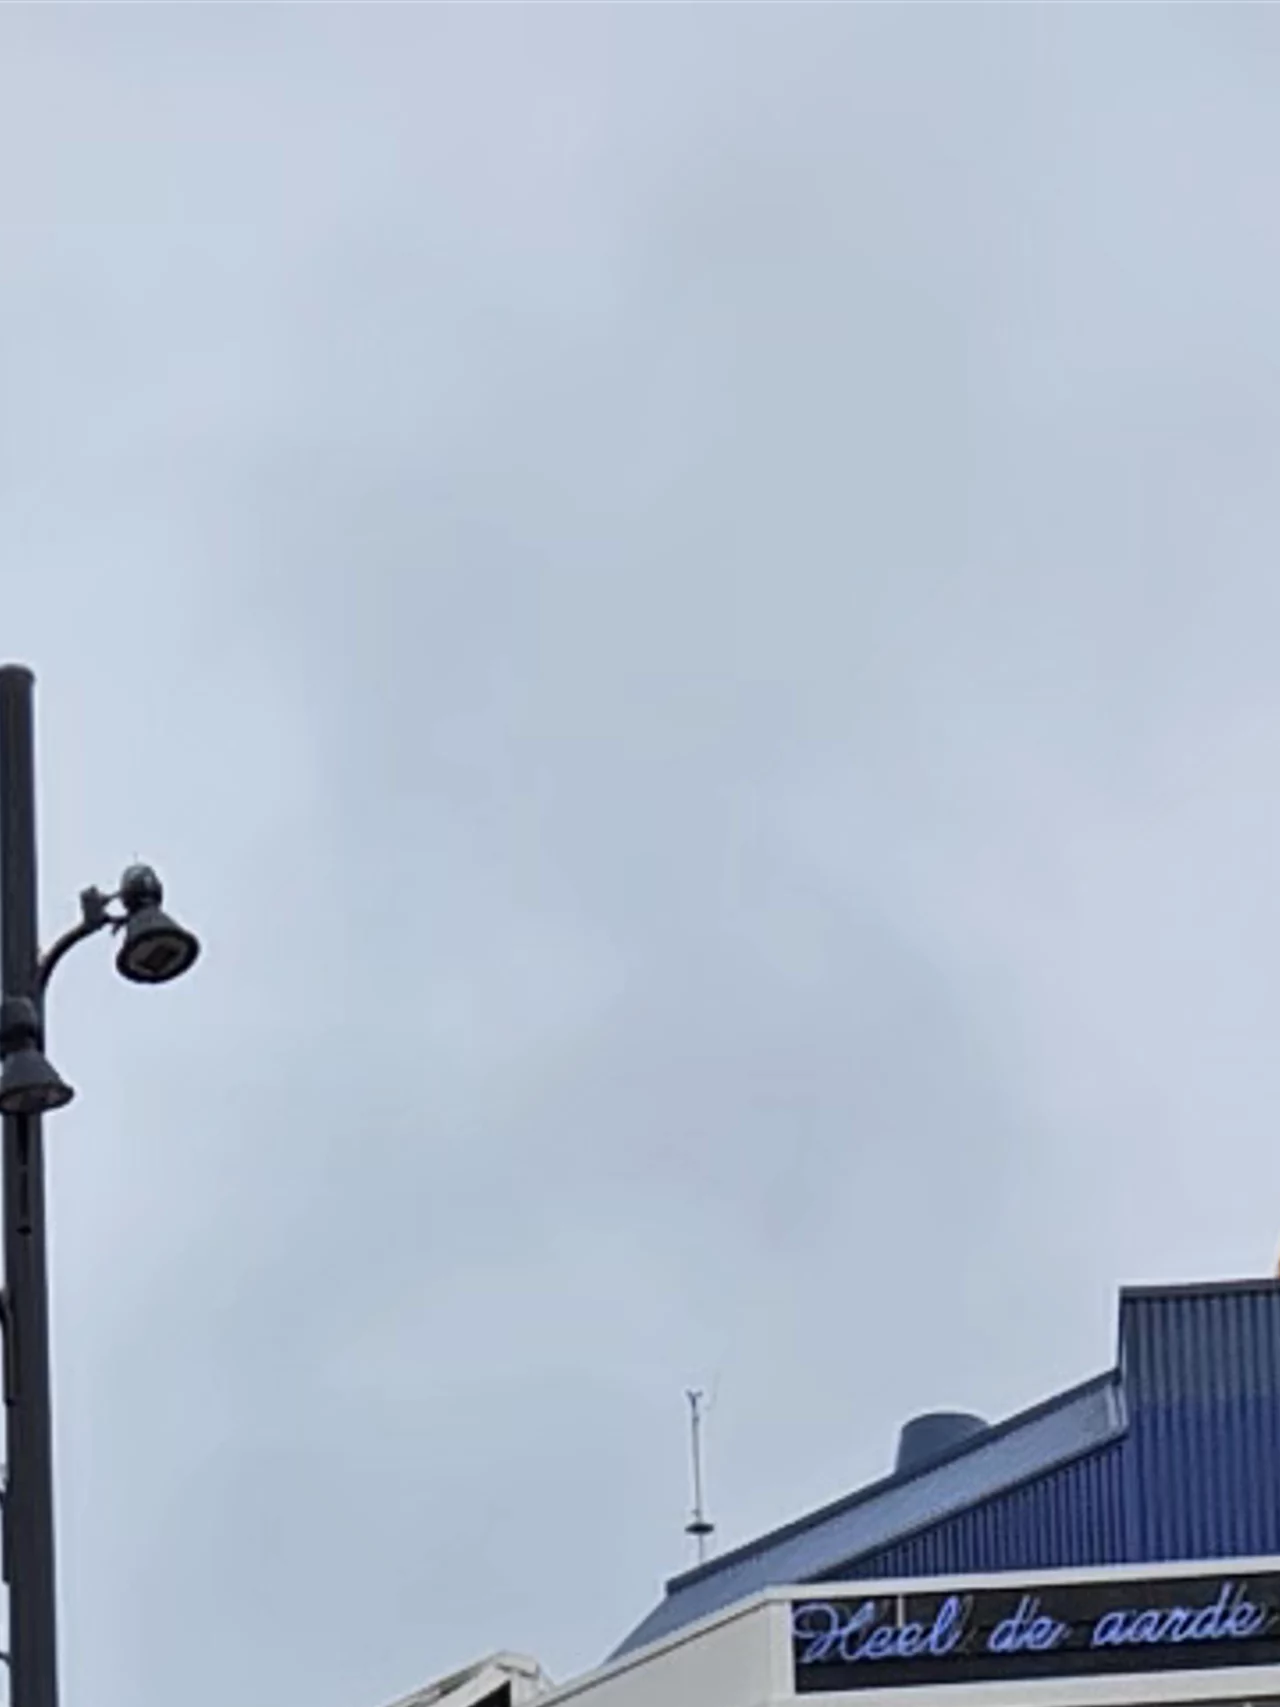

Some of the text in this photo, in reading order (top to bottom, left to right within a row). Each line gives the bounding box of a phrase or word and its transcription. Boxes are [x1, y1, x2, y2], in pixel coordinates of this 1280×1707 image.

[794, 1594, 961, 1664] Heel
[988, 1594, 1065, 1654] de
[1092, 1581, 1266, 1646] aarde
